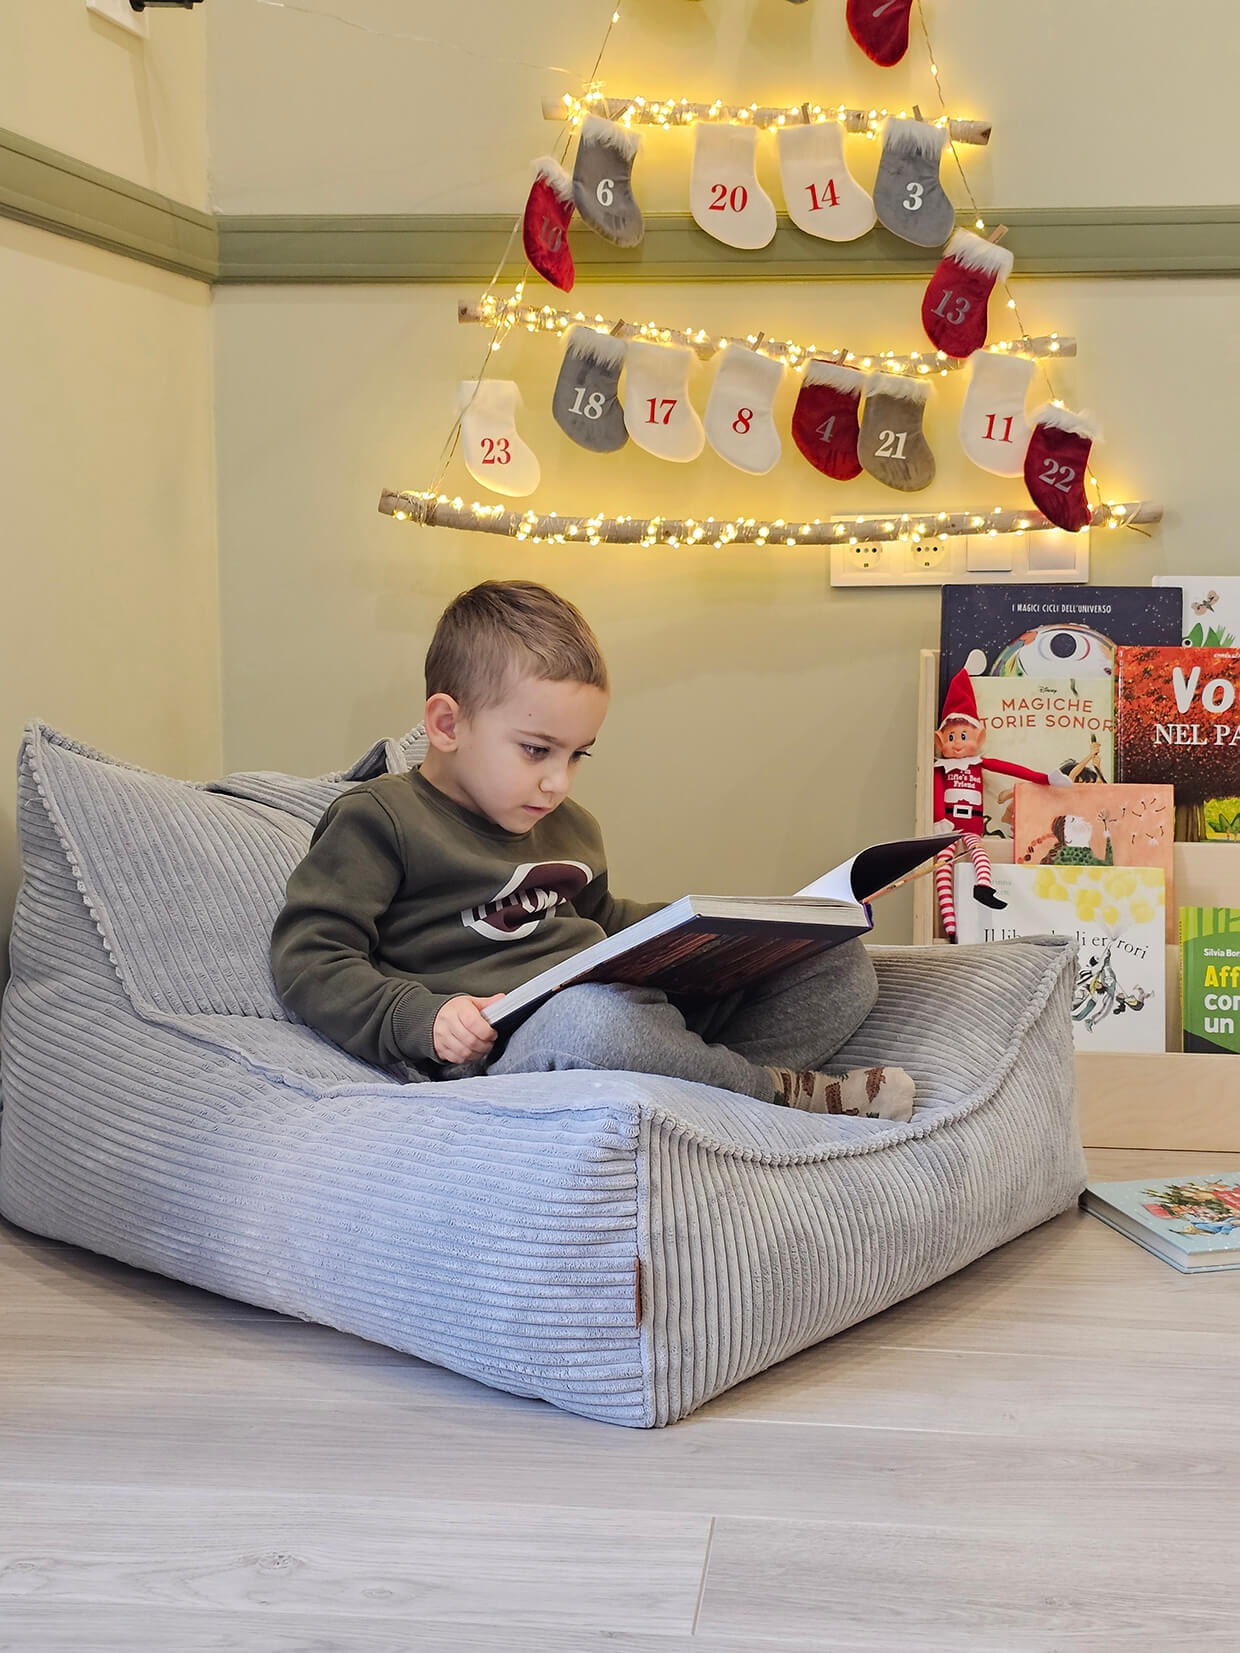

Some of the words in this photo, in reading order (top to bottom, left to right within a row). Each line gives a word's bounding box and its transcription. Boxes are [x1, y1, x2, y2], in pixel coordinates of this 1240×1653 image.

[596, 178, 615, 207] 6
[708, 183, 748, 213] 20
[804, 178, 841, 212] 14
[902, 182, 924, 211] 3
[930, 289, 971, 325] 13
[567, 386, 606, 420] 18
[644, 397, 677, 425] 17
[732, 407, 753, 434] 8
[815, 415, 836, 443] 4
[981, 413, 1014, 443] 11
[480, 437, 511, 465] 23
[874, 430, 907, 460] 21
[1038, 458, 1075, 493] 22
[1017, 603, 1040, 613] MAGICI
[1042, 603, 1060, 613] CICLI
[1061, 604, 1112, 613] DELL'UNIVERSO
[1172, 665, 1236, 714] Vo
[1001, 697, 1094, 713] MAGICHE
[1153, 723, 1209, 746] NEL
[1203, 947, 1225, 957] Silvia
[1204, 1016, 1235, 1035] un
